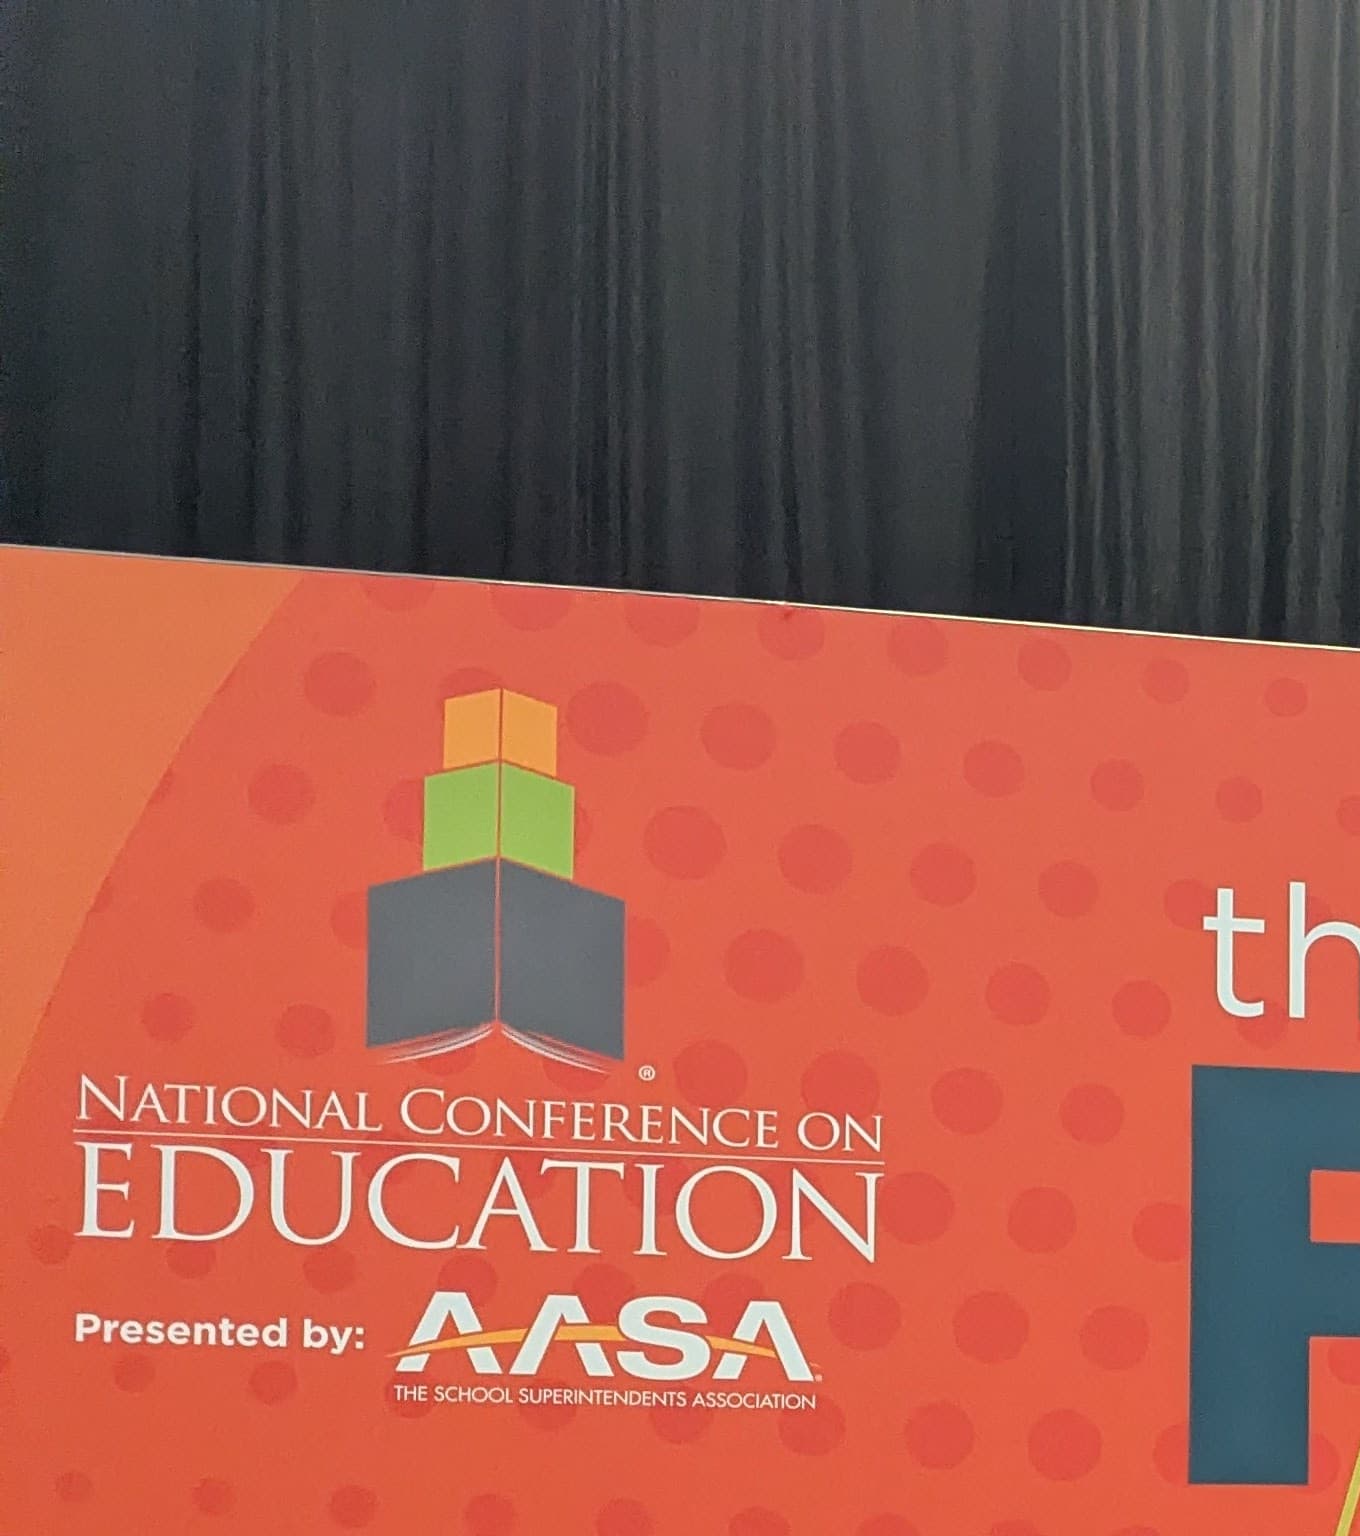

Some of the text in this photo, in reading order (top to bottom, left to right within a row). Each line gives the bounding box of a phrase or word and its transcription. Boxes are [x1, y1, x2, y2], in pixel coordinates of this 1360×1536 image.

[77, 1073, 882, 1152] NATIONAL CONFERENCE ON
[73, 1141, 885, 1263] EDUCATION
[75, 1313, 364, 1355] Presented by:
[395, 1291, 815, 1382] AASA
[394, 1386, 817, 1410] THE SCHOOL SUPERINTENDENTS ASSOCIATION
